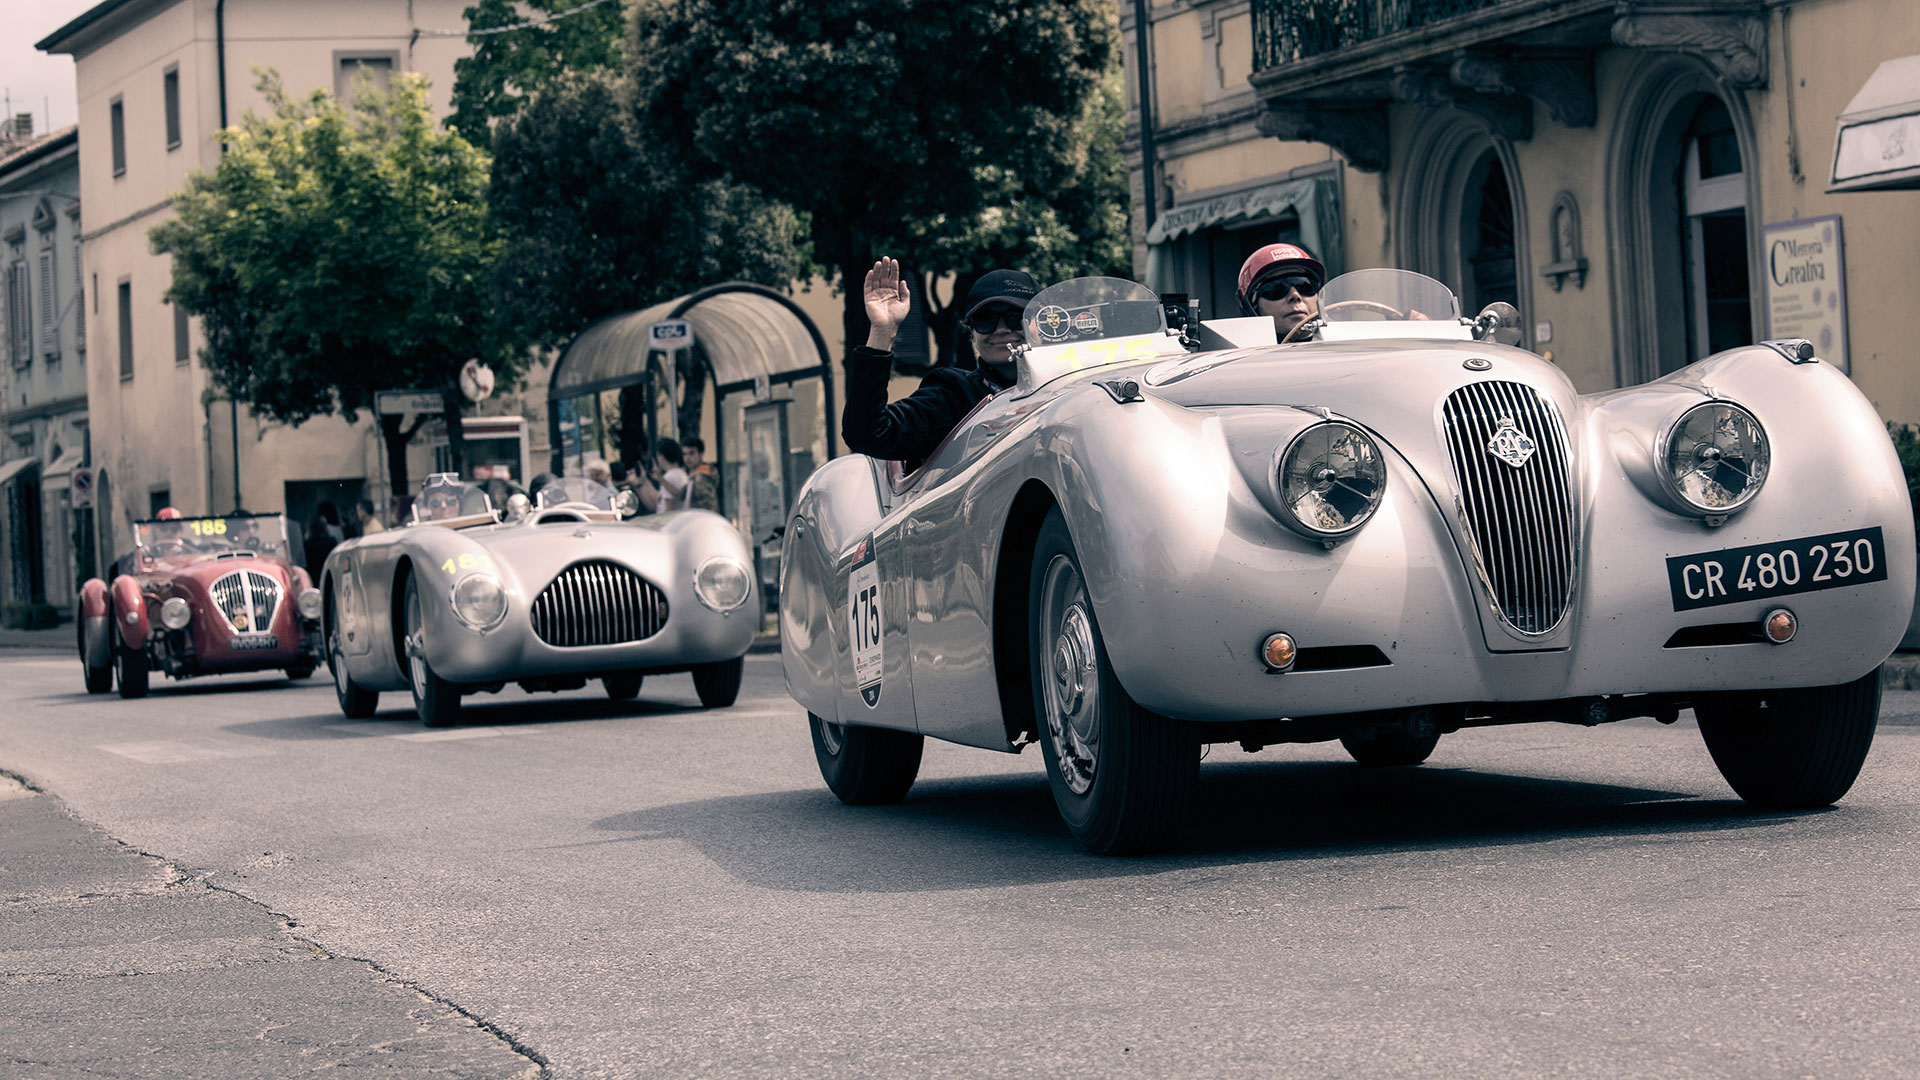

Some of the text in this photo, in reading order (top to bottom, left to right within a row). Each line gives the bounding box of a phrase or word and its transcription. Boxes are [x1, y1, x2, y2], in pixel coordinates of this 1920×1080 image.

[1770, 240, 1825, 287] Creativa
[1788, 239, 1822, 258] Merceria
[1056, 338, 1160, 376] 175
[190, 519, 227, 536] 185
[1682, 538, 1875, 600] CR 480 230
[852, 585, 880, 652] 175
